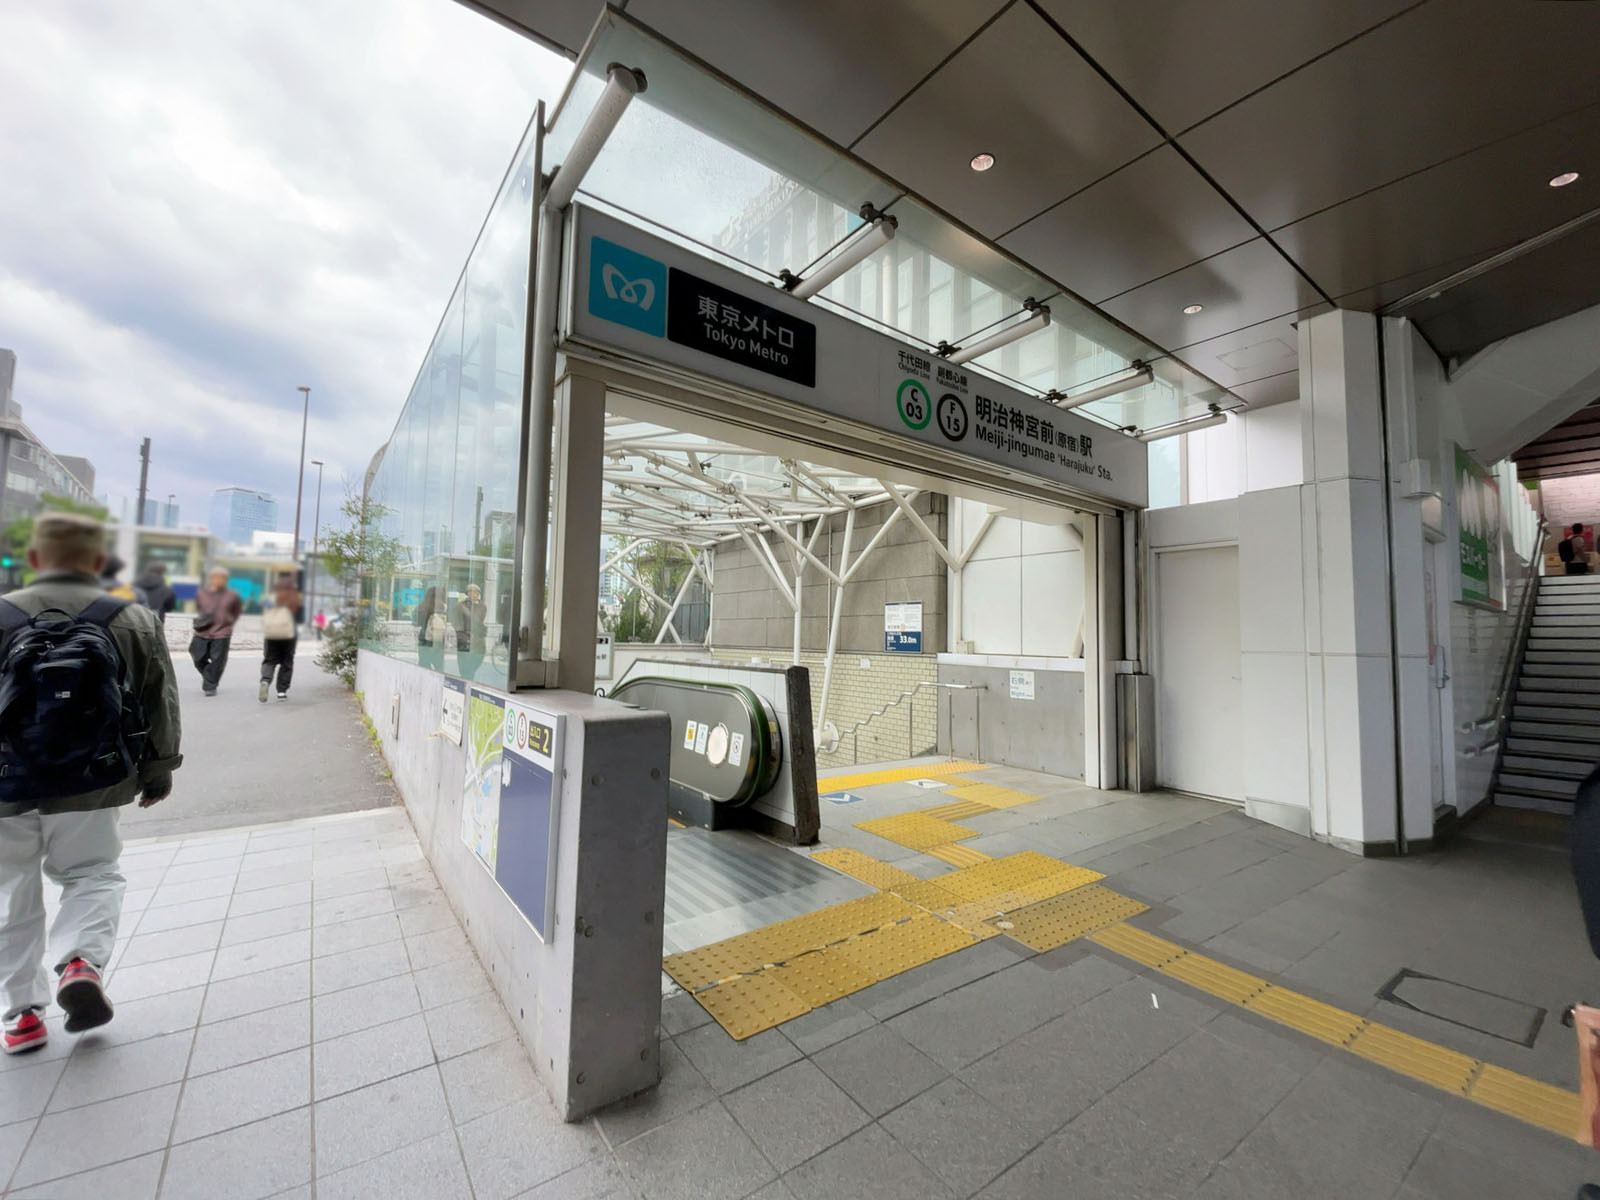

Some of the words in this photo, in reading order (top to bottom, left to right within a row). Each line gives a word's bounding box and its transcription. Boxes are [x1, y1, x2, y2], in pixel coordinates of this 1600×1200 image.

[697, 294, 795, 349] 東京メトロ
[703, 322, 746, 351] Tokyo
[749, 340, 789, 366] Metro
[898, 350, 931, 372] 千代田線
[898, 362, 919, 376] Chiyoda
[937, 365, 968, 387] 副都心線
[911, 388, 919, 403] C
[906, 402, 923, 420] 03
[950, 402, 956, 414] F
[946, 415, 960, 432] 15
[976, 424, 1055, 464] Meiji-jingumae
[1097, 464, 1113, 482] Sta.
[542, 728, 550, 754] 2
